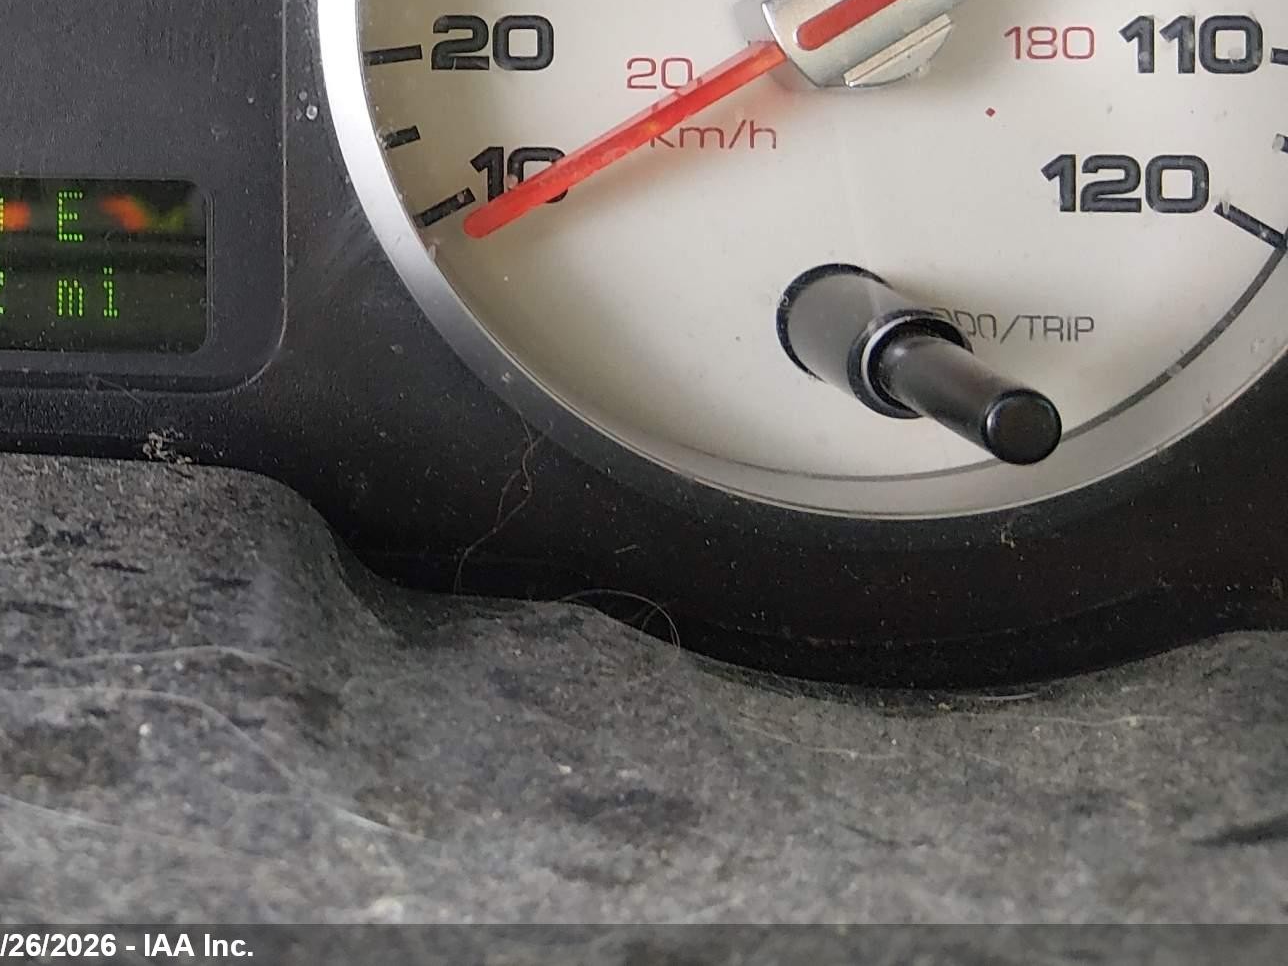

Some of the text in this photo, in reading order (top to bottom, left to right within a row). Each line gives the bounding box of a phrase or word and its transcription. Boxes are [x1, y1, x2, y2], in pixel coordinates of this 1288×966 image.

[431, 15, 554, 71] 20
[1004, 26, 1095, 60] 180
[1119, 15, 1263, 74] 110
[626, 57, 694, 91] 20
[470, 146, 568, 203] 10
[1041, 154, 1210, 213] 120
[56, 190, 85, 242] E
[57, 267, 119, 319] mi
